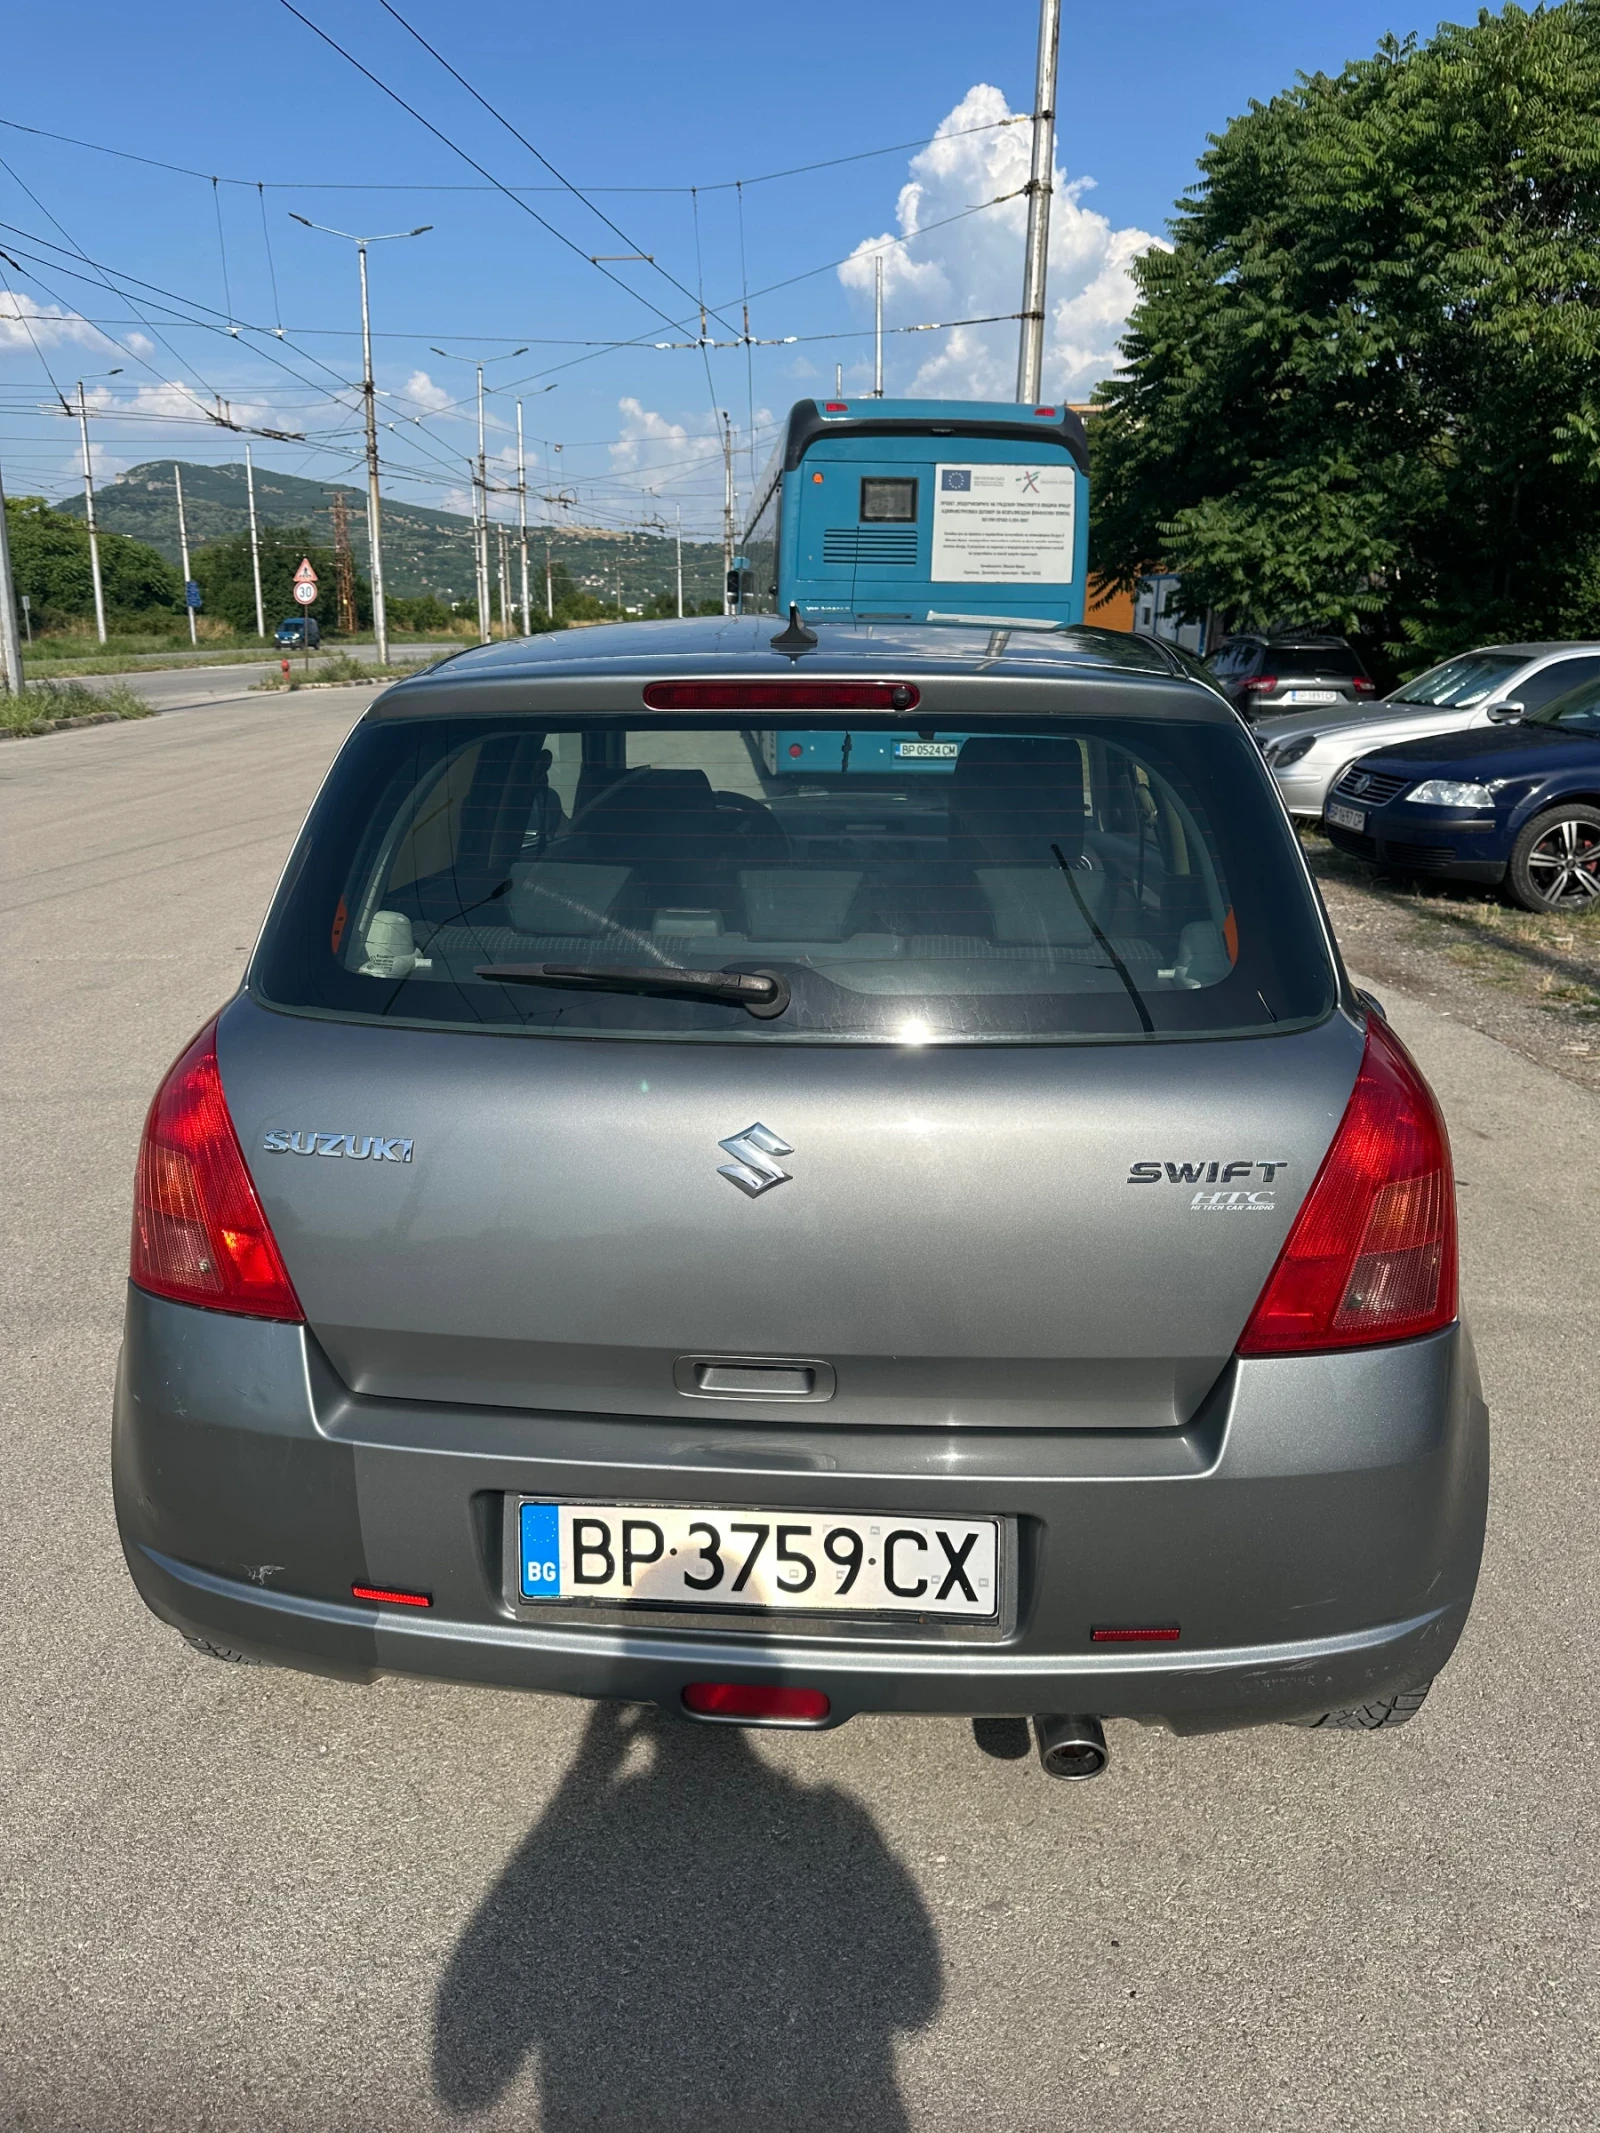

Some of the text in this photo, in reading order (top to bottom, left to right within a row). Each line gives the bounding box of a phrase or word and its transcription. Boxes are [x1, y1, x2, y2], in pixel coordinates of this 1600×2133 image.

[299, 586, 312, 598] 30
[902, 745, 956, 757] BP 0524 CM
[263, 1129, 414, 1163] SUZUKI
[1127, 1160, 1289, 1184] SWIFT
[1190, 1191, 1276, 1205] HTC
[573, 1518, 979, 1602] BP 3759 CX
[527, 1561, 556, 1582] BG
